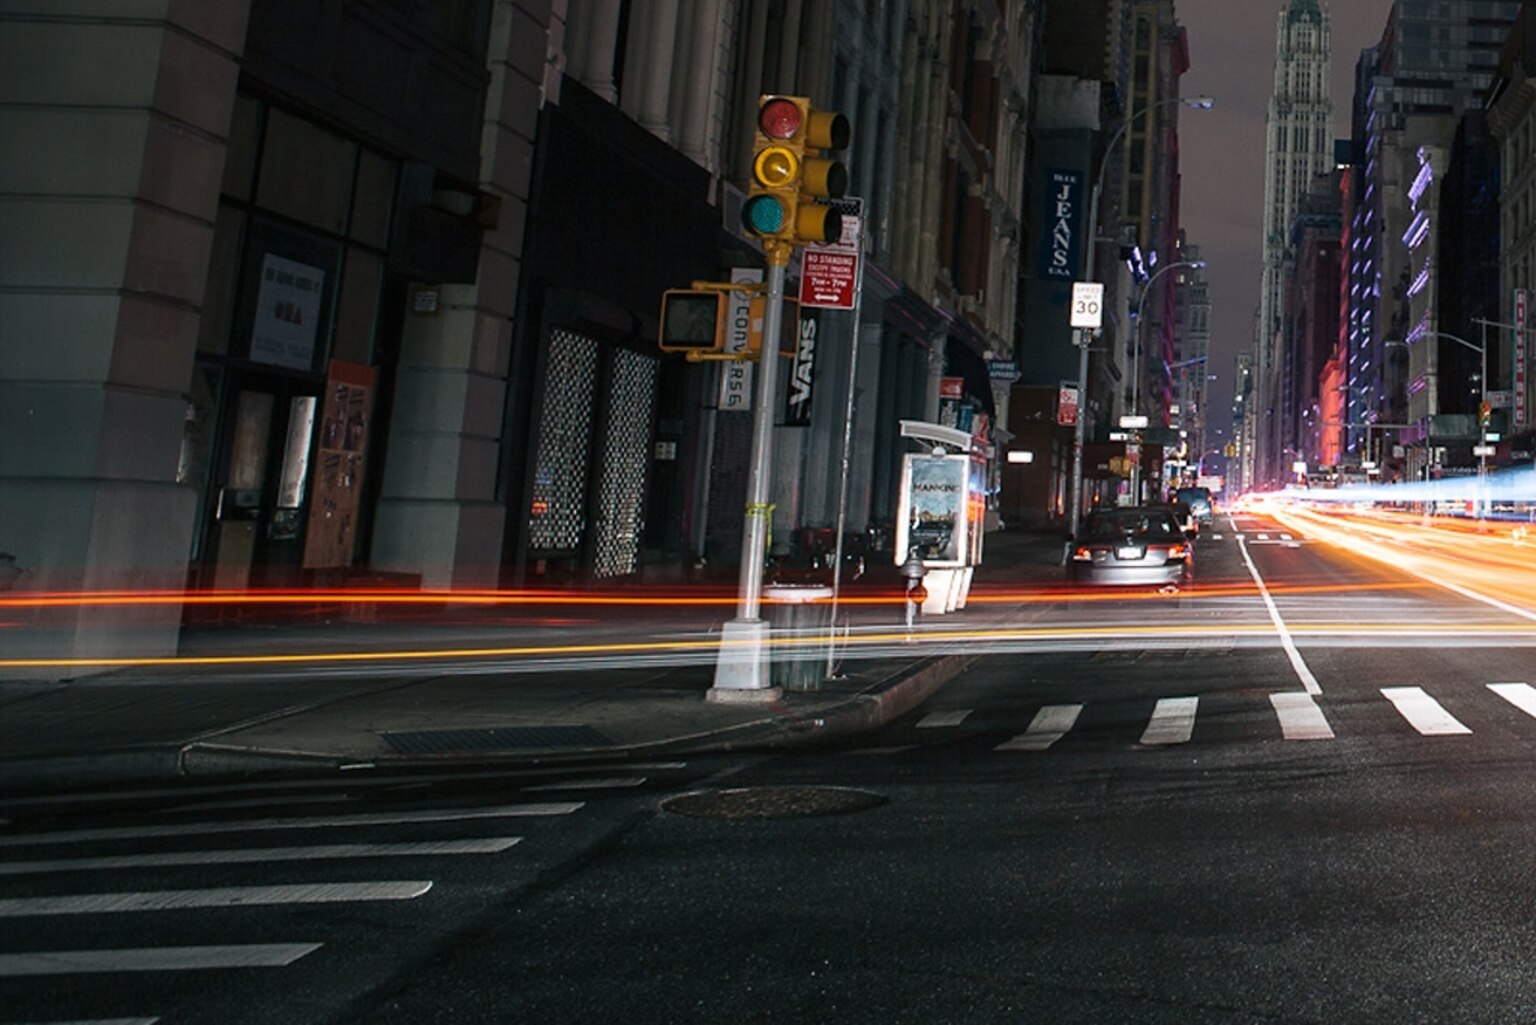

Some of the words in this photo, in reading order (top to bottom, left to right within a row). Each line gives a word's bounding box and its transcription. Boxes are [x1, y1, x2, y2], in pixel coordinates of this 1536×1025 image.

[1051, 184, 1073, 267] JEANS
[807, 254, 818, 264] NO
[819, 255, 853, 267] STANDING
[1076, 300, 1099, 315] 30
[789, 318, 817, 406] VANS
